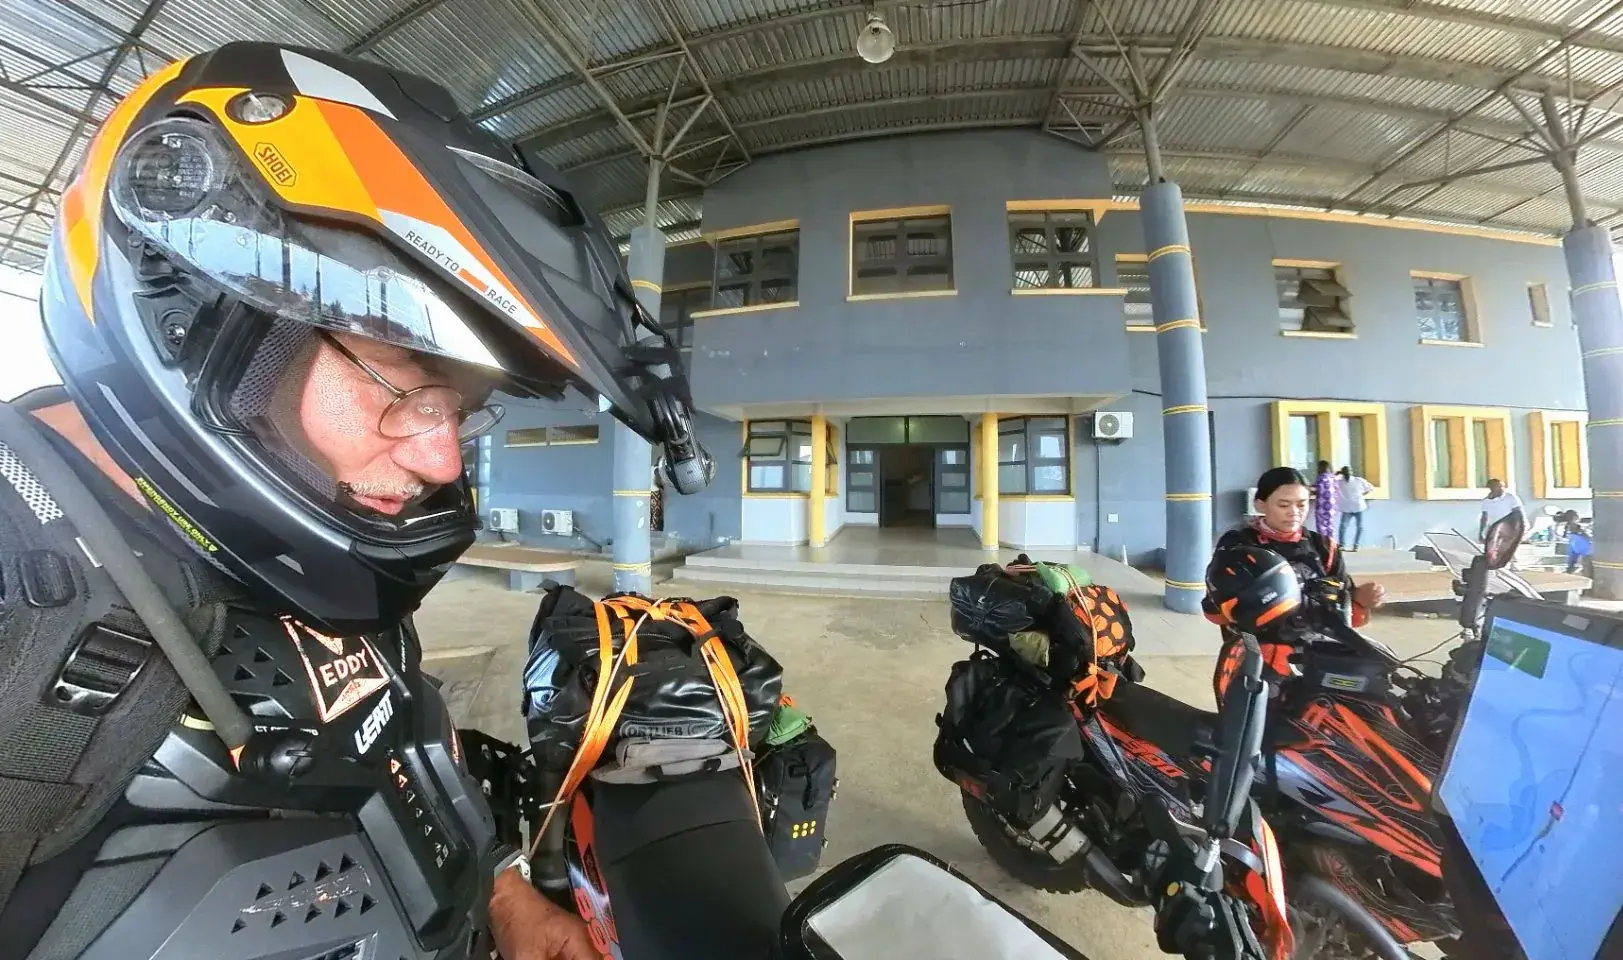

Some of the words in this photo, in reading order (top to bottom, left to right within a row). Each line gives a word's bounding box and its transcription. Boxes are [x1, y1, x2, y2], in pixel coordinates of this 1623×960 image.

[258, 146, 293, 183] SHOEI
[405, 230, 444, 259] READY
[435, 257, 460, 272] TO
[487, 289, 517, 314] RACE
[319, 648, 369, 687] EDDY
[354, 689, 394, 754] LEATT
